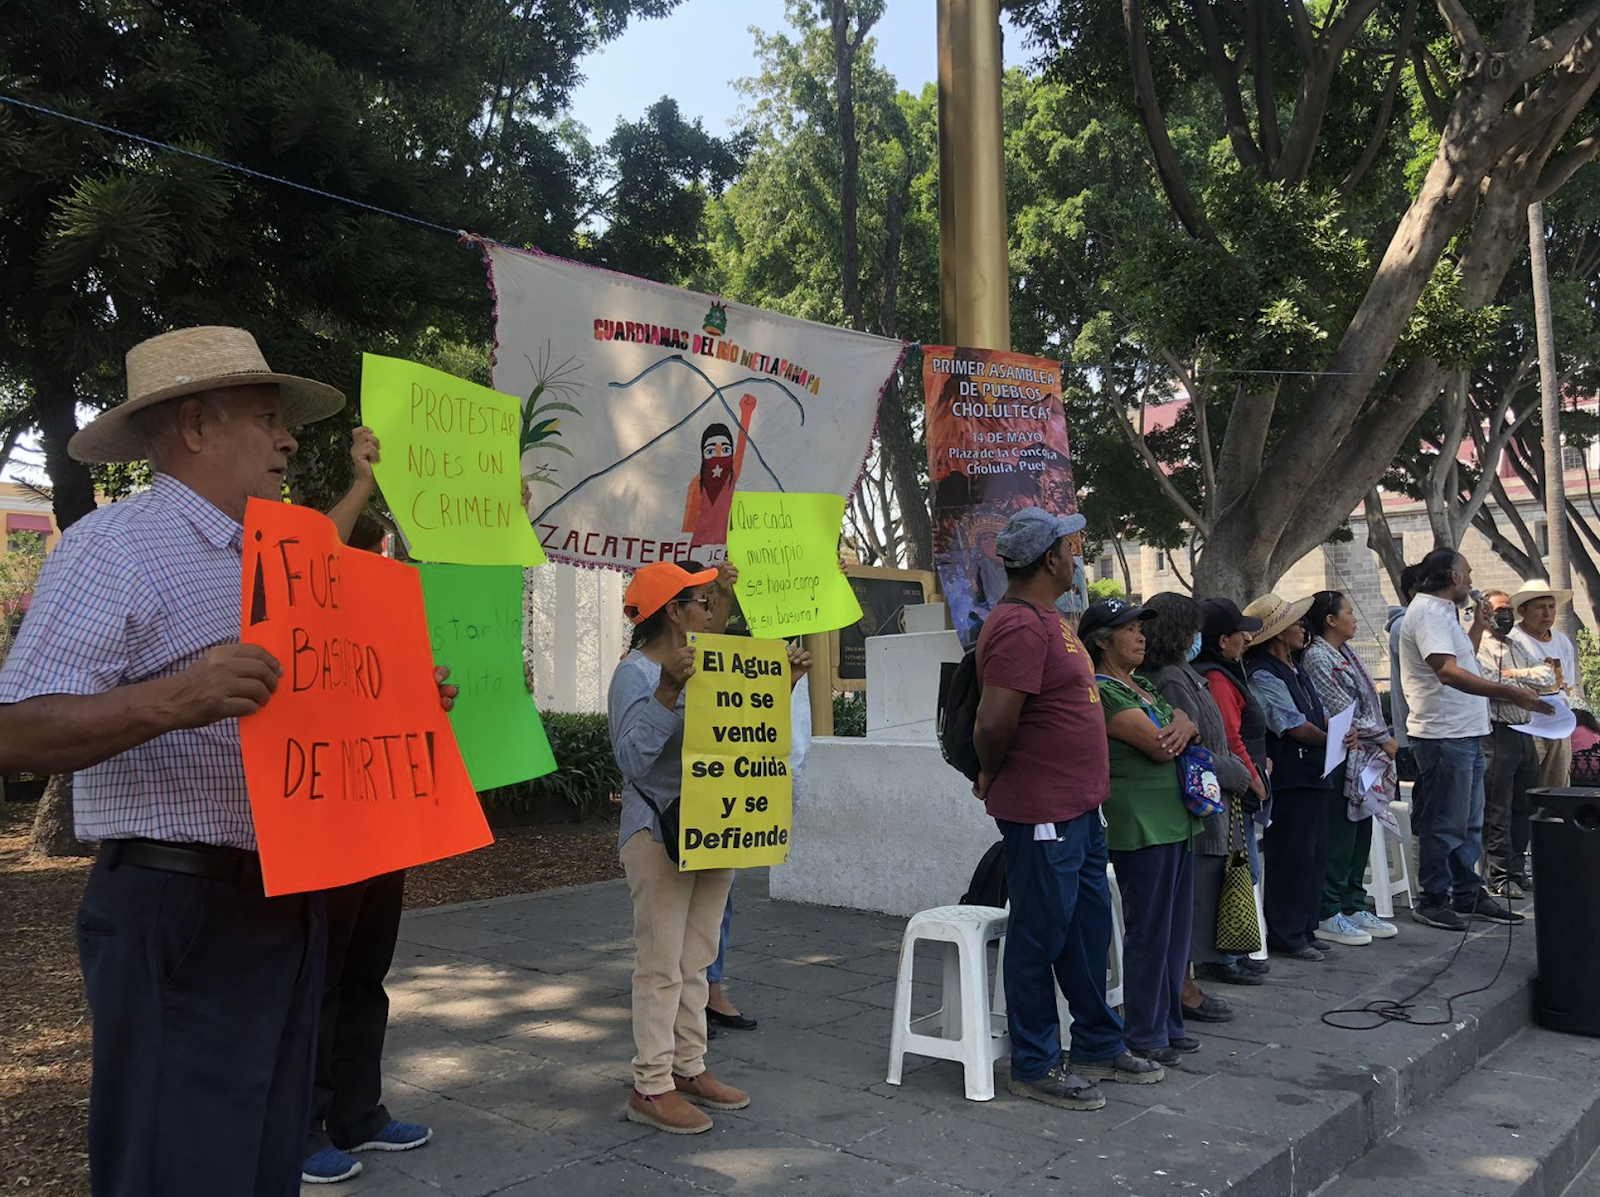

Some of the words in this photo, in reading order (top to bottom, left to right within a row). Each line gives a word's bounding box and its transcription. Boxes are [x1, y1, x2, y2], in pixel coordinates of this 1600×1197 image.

[593, 318, 688, 351] GUARDIANAS
[692, 333, 714, 357] DEL
[716, 339, 738, 364] RÍO
[932, 358, 985, 377] PRIMER
[988, 363, 1055, 385] ASAMBLEA
[959, 381, 978, 396] DE
[982, 383, 1042, 401] PUEBLOS
[411, 382, 519, 444] PROTESTAR
[972, 432, 984, 443] 14
[987, 432, 1003, 443] DE
[1007, 432, 1043, 444] MAYO
[408, 444, 436, 478] NO
[443, 451, 464, 479] ES
[477, 451, 504, 475] UN
[948, 447, 979, 459] Plaza
[980, 448, 995, 459] de
[997, 447, 1009, 458] la
[966, 462, 1017, 475] Cholula,
[411, 490, 511, 530] CRIMEN
[763, 499, 793, 530] cada
[747, 540, 804, 577] municipio
[745, 579, 763, 597] se
[767, 573, 791, 602] haga
[793, 575, 820, 601] cargo
[747, 609, 758, 631] de
[760, 615, 773, 629] su
[702, 650, 724, 673] El
[731, 652, 783, 679] Agua
[716, 690, 743, 708] no
[750, 691, 774, 709] se
[712, 721, 777, 743] vende
[284, 738, 330, 800] DE
[691, 760, 725, 778] se
[733, 756, 787, 778] Cuida
[720, 796, 737, 819] y
[744, 795, 769, 813] se
[684, 825, 788, 850] Defiende
